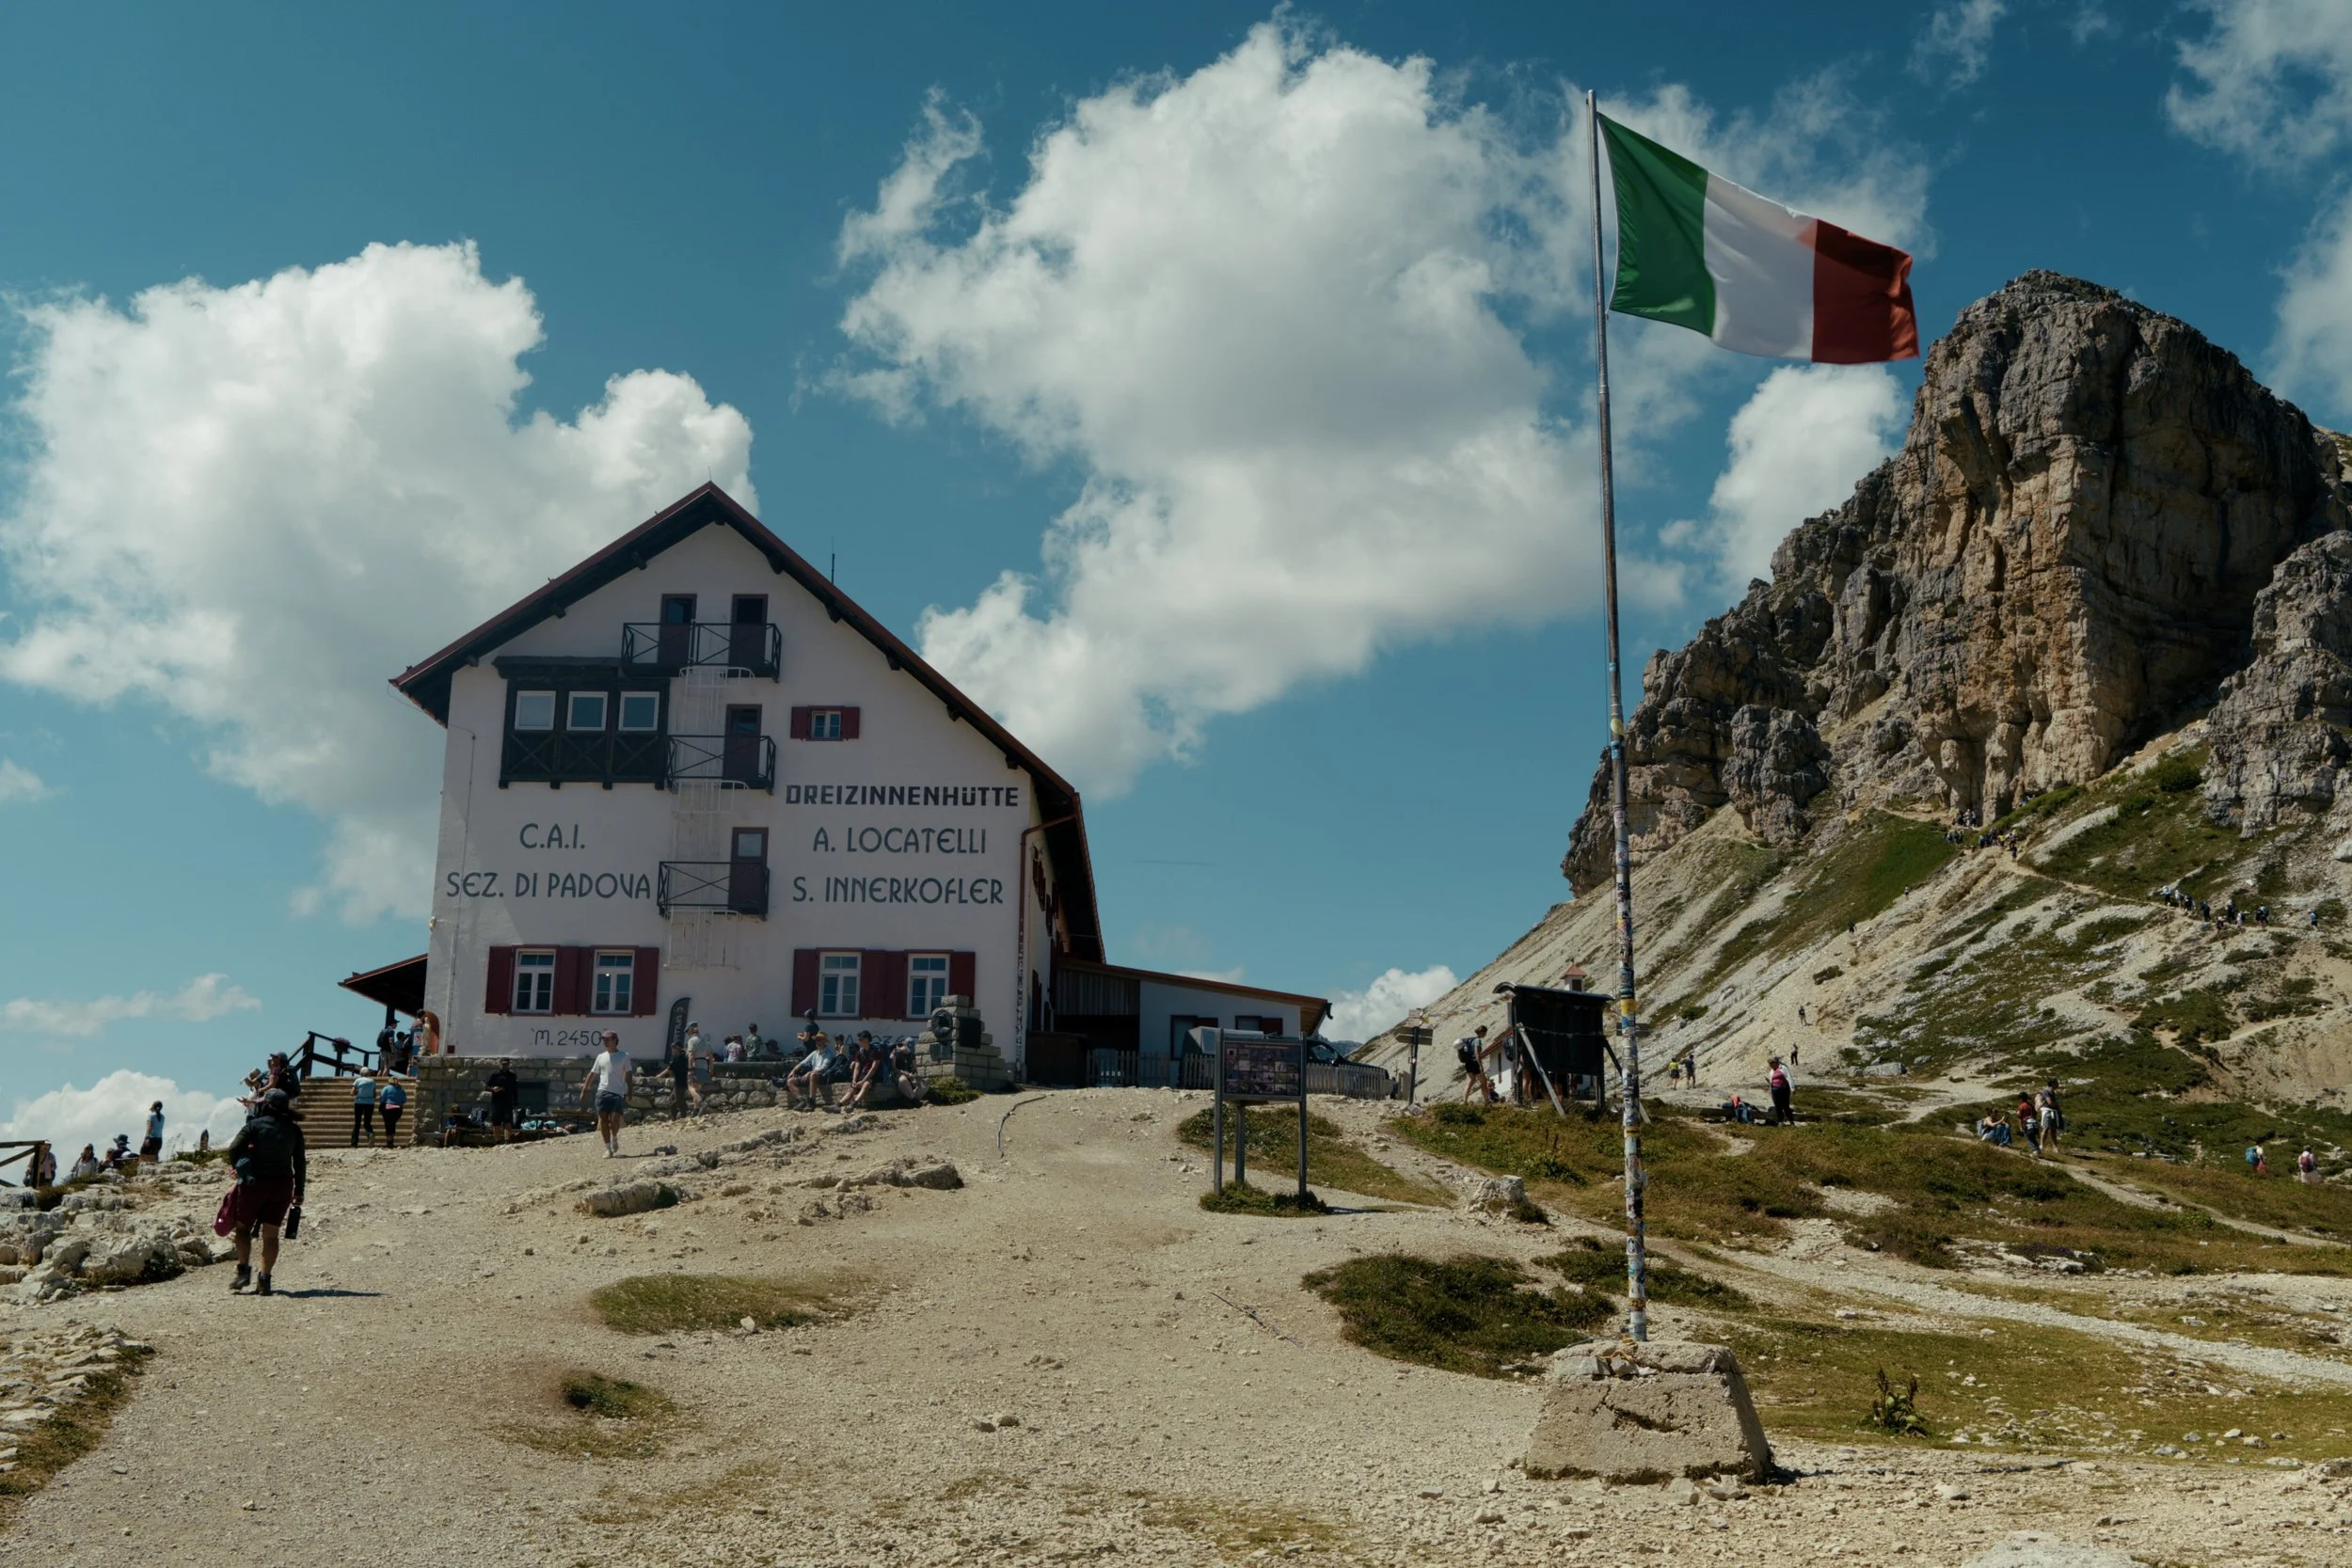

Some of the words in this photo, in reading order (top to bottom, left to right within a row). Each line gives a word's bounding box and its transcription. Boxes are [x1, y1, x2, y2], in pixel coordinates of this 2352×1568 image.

[785, 784, 1019, 808] DREIZINNENHÜTTE
[519, 822, 586, 849] C.A.I.
[812, 826, 836, 853] A.
[846, 827, 987, 855] LOCATELLI
[446, 871, 504, 898] SEZ.
[515, 872, 538, 898] DI
[547, 872, 651, 899] PADOVA
[792, 876, 815, 903] S.
[825, 876, 1004, 905] INNERKOFLER
[557, 1029, 602, 1047] 2450
